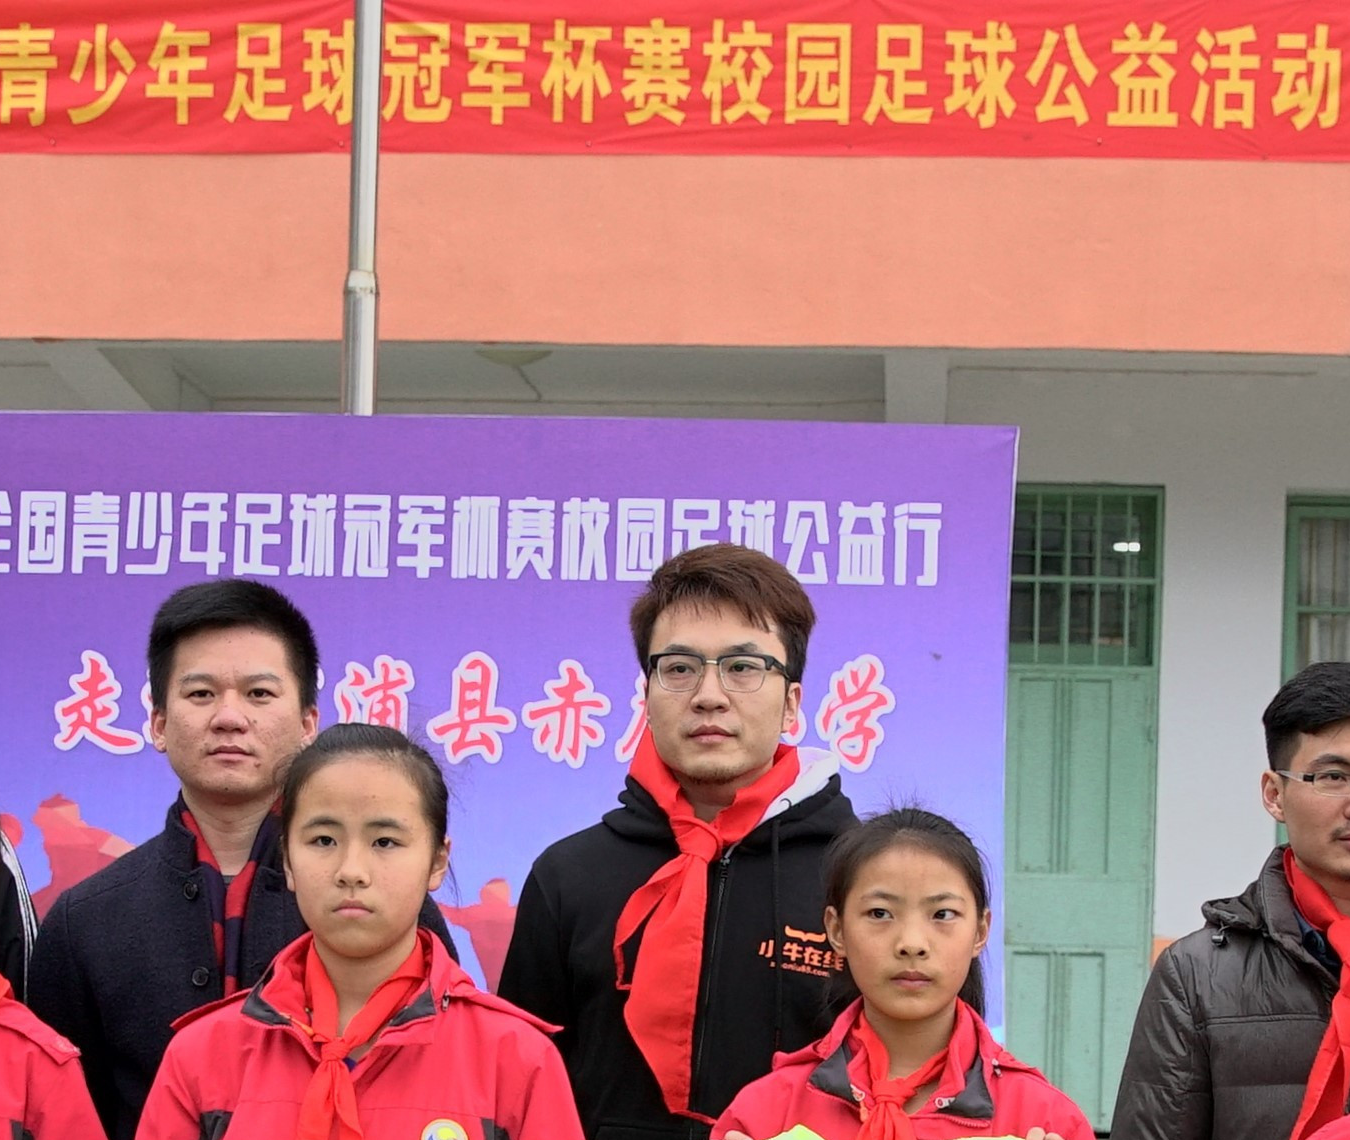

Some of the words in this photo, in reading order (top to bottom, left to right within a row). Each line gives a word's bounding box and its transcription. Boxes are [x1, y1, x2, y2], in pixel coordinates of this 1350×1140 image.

[55, 651, 894, 769] 走浦县赤学
